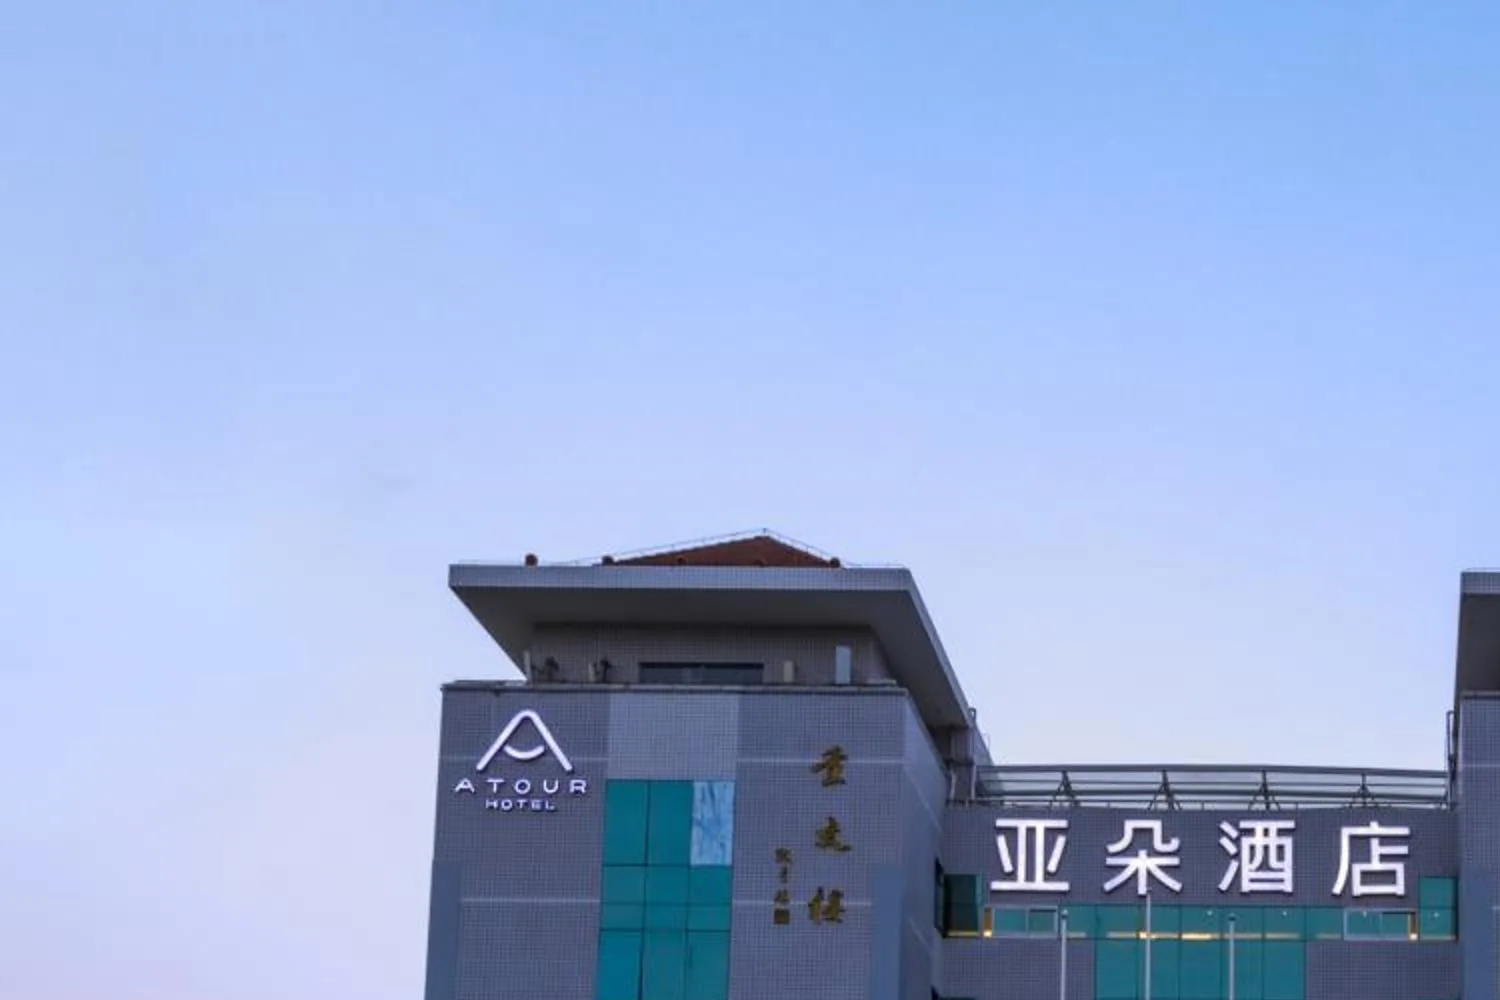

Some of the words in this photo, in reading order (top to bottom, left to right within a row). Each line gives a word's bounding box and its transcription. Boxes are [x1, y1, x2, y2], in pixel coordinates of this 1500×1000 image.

[455, 778, 587, 794] ATOUR
[486, 799, 555, 811] HOTEL
[991, 819, 1411, 896] 亚朵酒店
